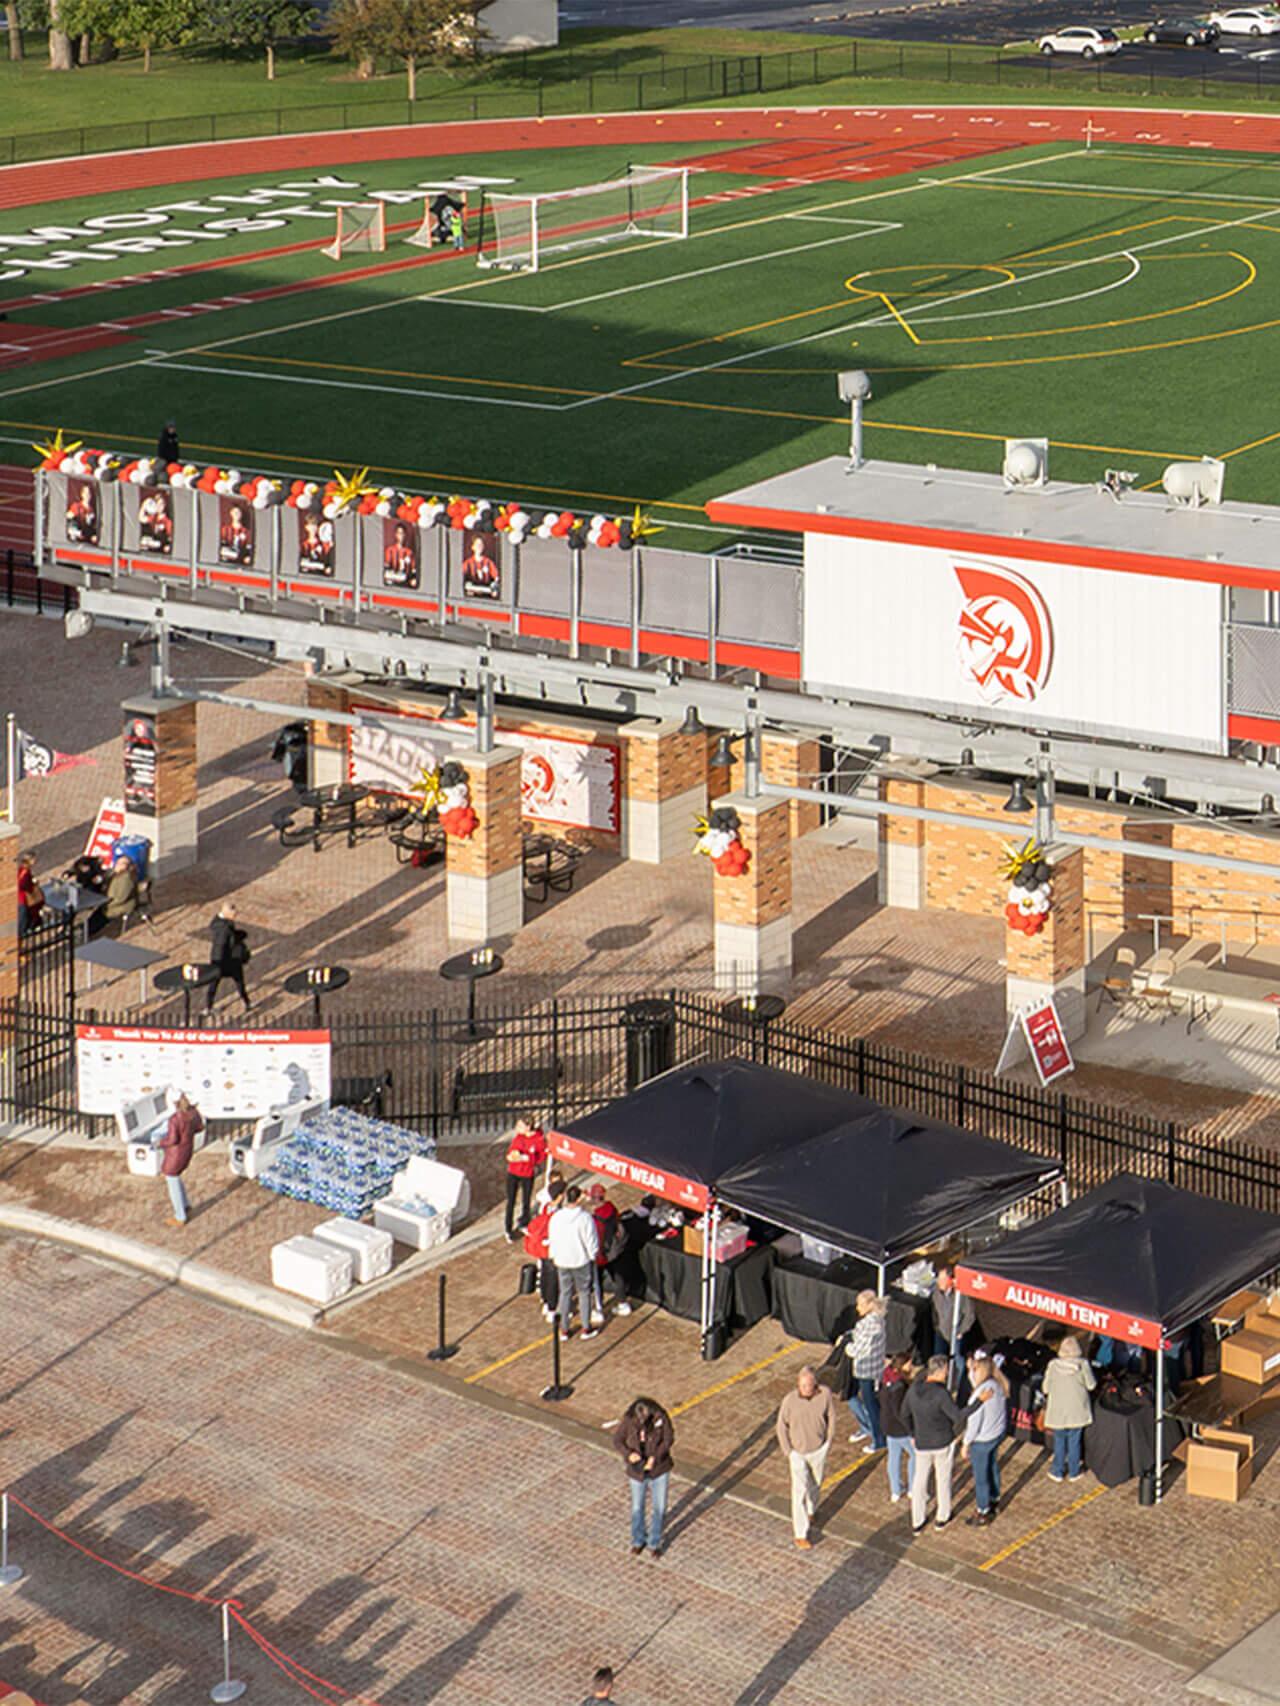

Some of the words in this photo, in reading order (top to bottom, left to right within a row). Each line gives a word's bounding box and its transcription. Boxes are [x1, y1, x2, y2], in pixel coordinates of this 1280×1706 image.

[0, 176, 363, 253] MOTHY
[113, 1029, 141, 1040] Thank
[142, 1030, 160, 1040] You
[161, 1030, 172, 1041] To
[173, 1031, 185, 1041] All
[186, 1031, 197, 1041] Of
[198, 1032, 216, 1041] Our
[217, 1032, 245, 1042] Event
[246, 1032, 290, 1043] Sponsors
[590, 1151, 628, 1178] SPIRIT
[629, 1164, 666, 1192] WEAR
[1005, 1286, 1067, 1318] ALUMNI
[1069, 1303, 1111, 1330] TENT
